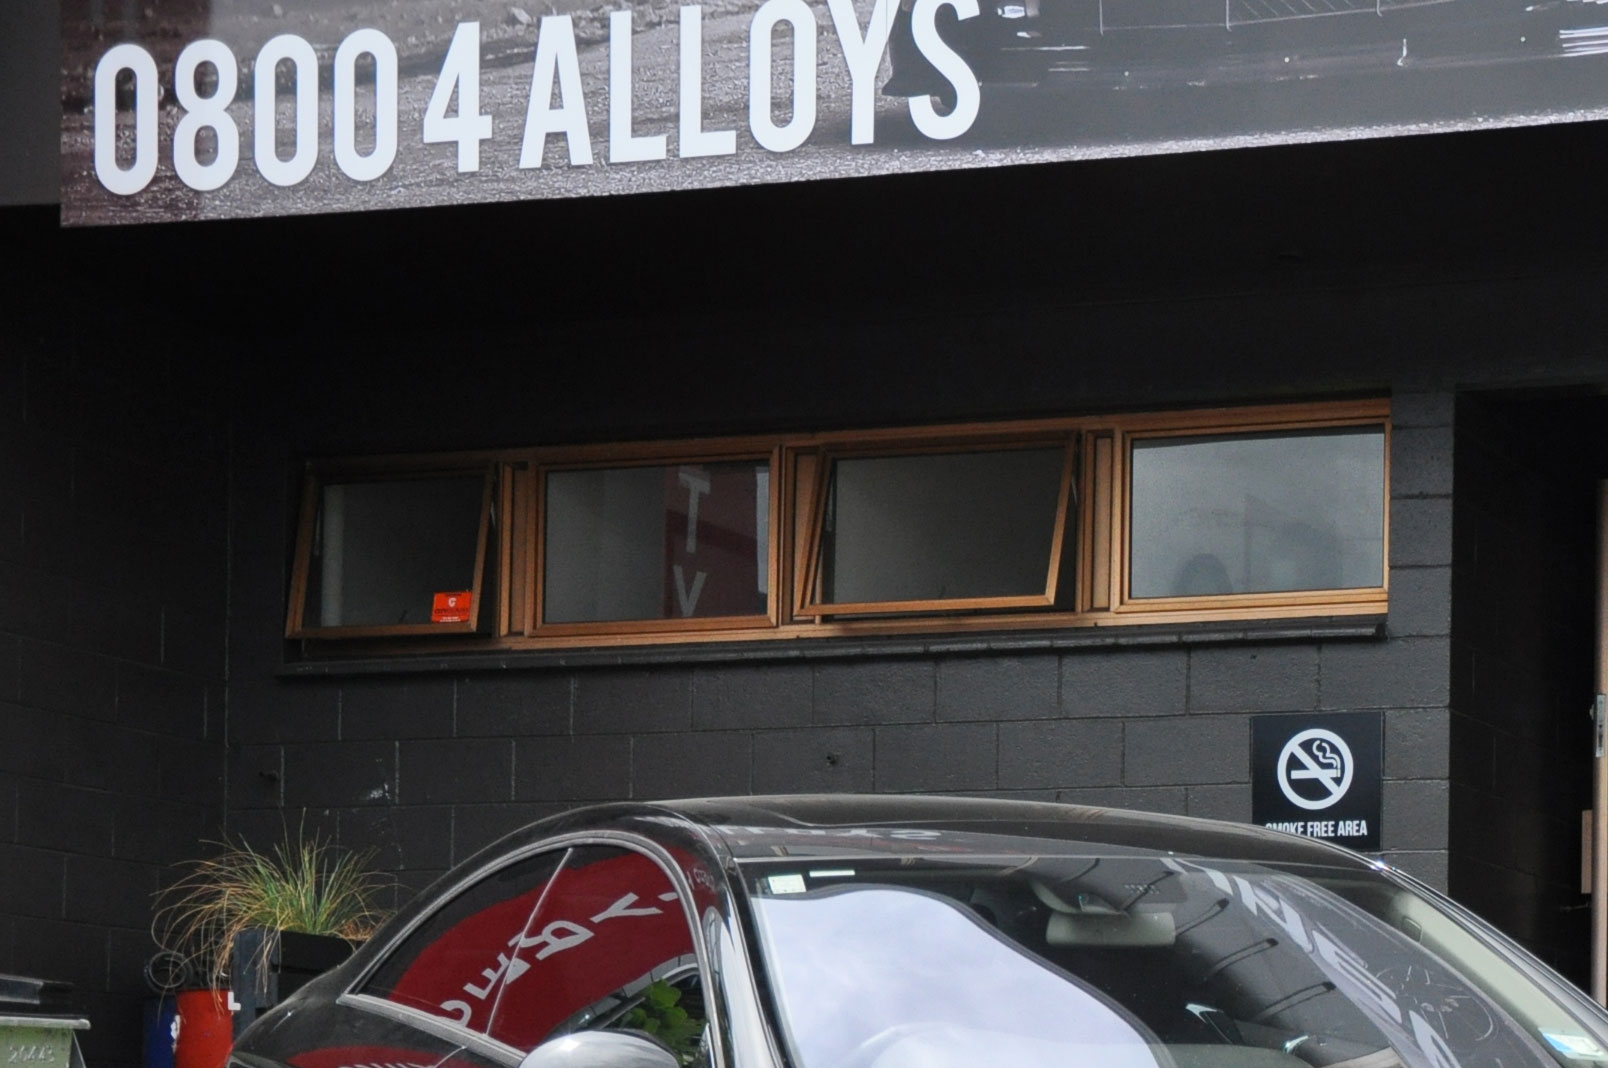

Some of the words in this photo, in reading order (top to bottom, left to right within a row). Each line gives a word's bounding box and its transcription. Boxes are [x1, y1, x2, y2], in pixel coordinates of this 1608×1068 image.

[94, 28, 399, 196] 0800
[422, 21, 493, 173] 4
[518, 0, 981, 169] ALLOYS
[1307, 820, 1335, 837] FREE
[1337, 820, 1368, 836] AREA
